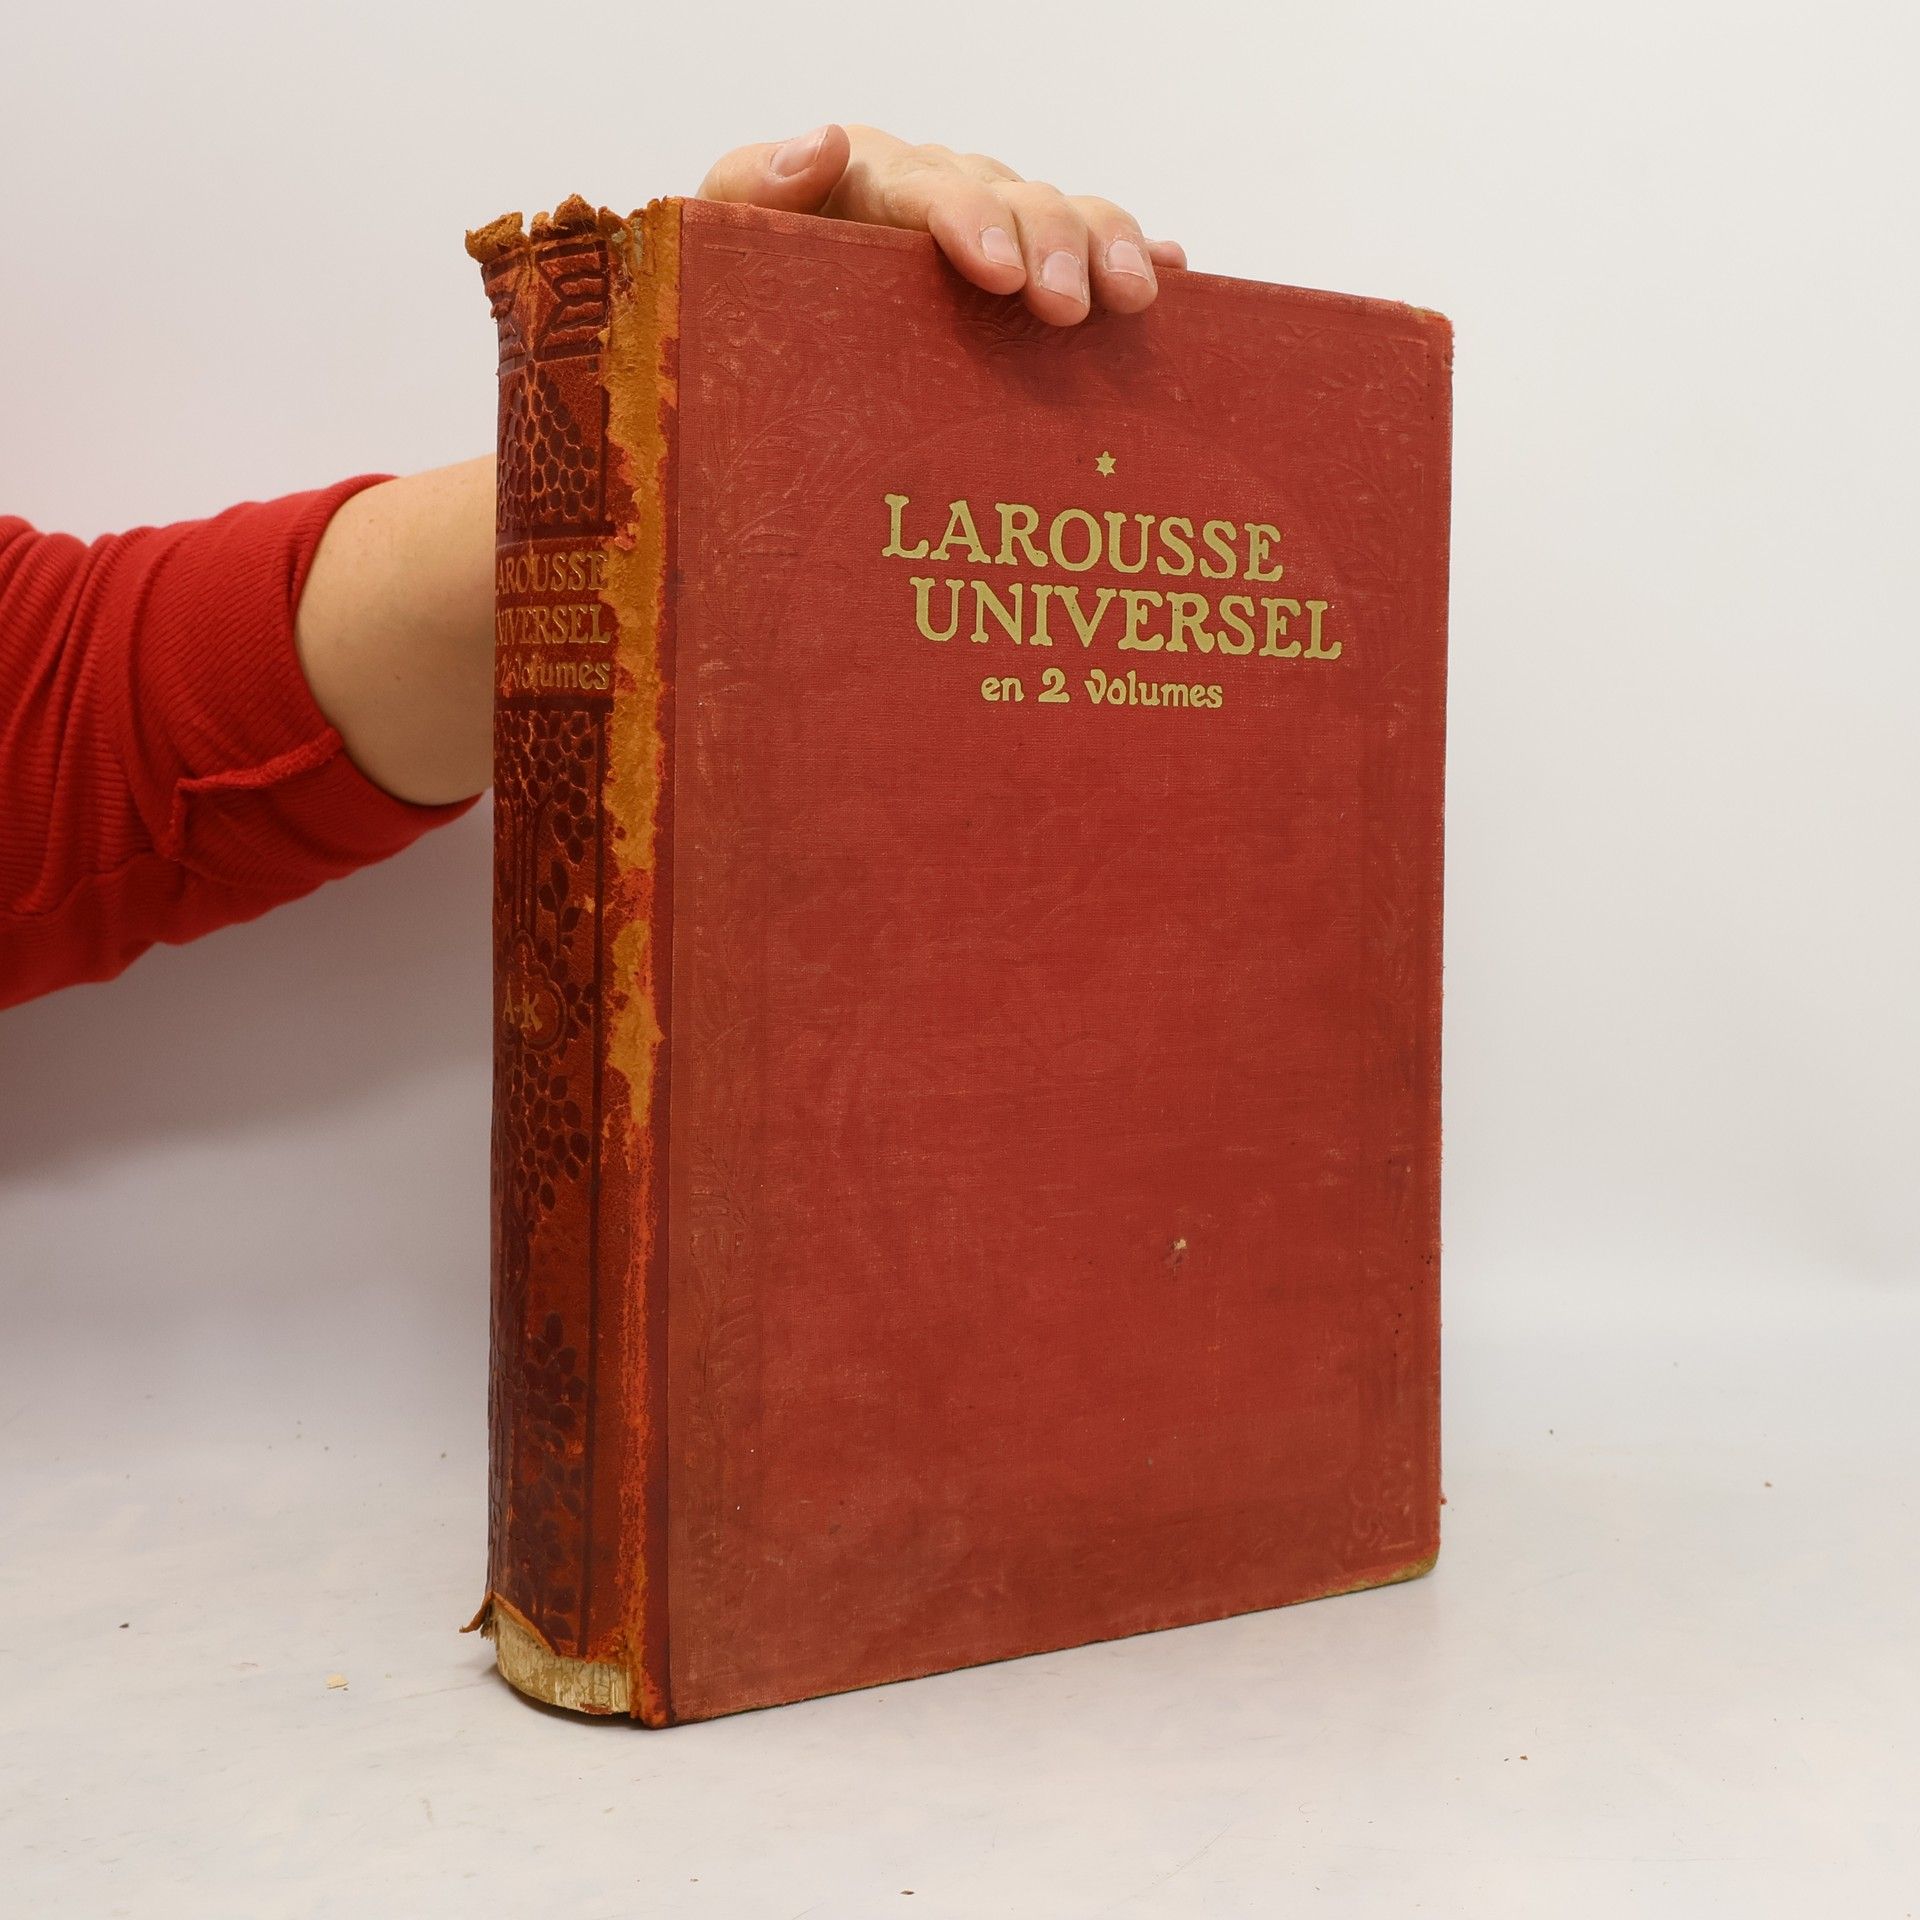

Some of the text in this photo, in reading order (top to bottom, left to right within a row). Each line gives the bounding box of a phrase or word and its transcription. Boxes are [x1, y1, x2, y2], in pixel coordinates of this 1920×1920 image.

[882, 493, 1284, 582] LAROUSSE
[496, 551, 610, 595] AROUSSE
[496, 604, 612, 646] NIVERSEL
[909, 577, 1343, 660] UNIVERSEL
[981, 676, 1025, 702] en
[1037, 667, 1071, 703] 2
